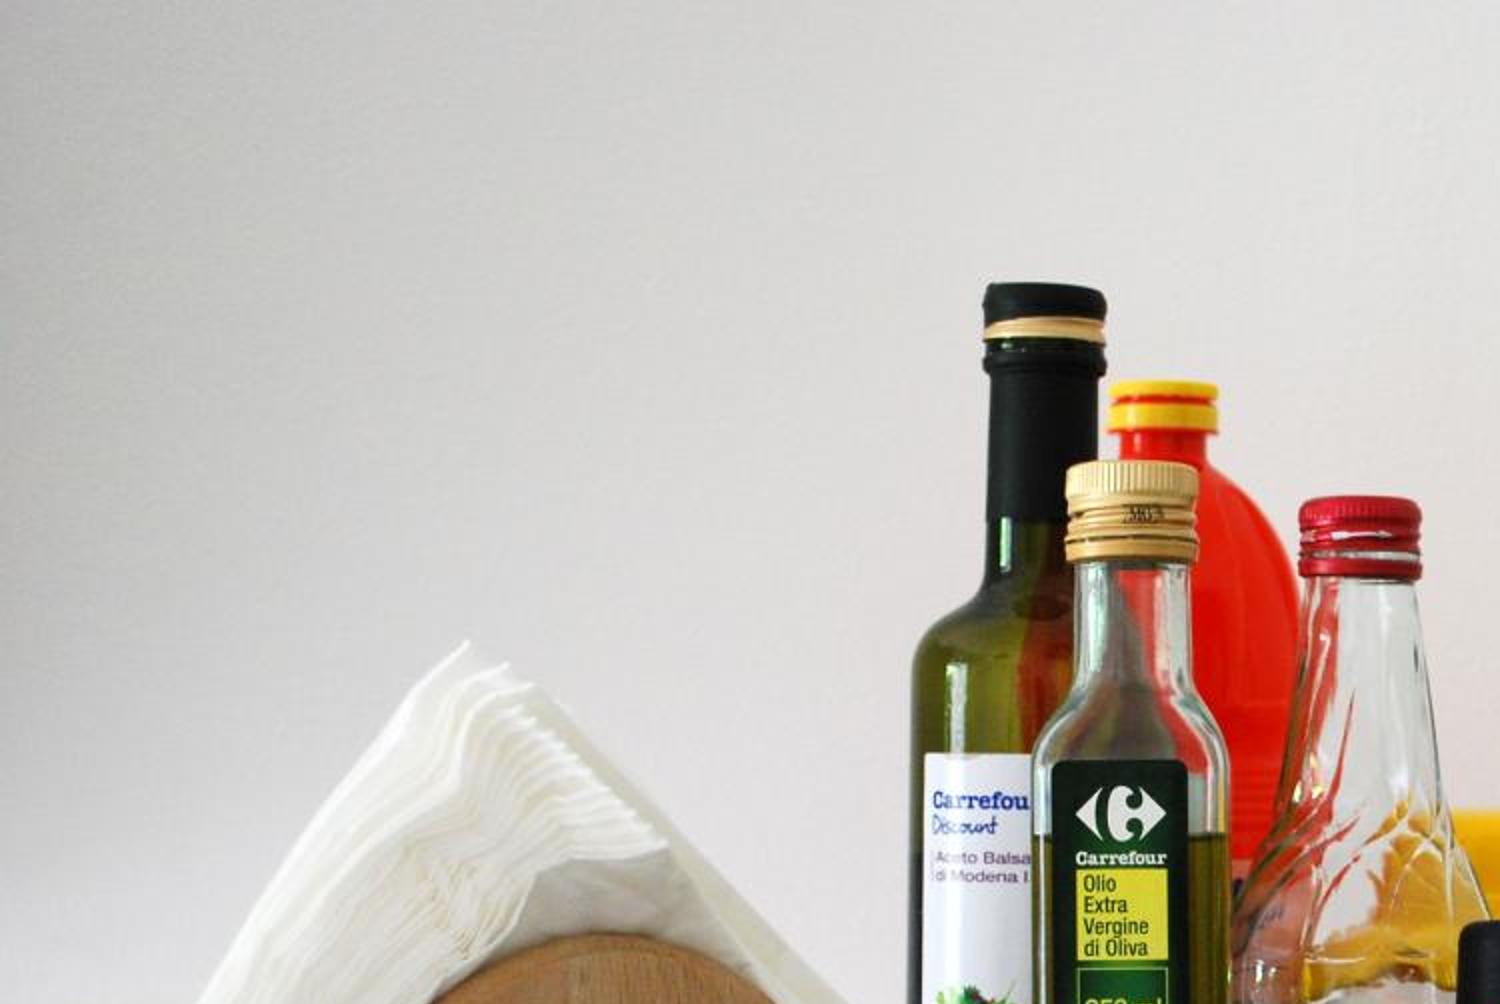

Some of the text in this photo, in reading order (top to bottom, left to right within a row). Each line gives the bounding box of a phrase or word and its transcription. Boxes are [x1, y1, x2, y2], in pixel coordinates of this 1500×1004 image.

[932, 790, 1030, 811] Carrefou
[935, 851, 1031, 865] Ato Balsa
[1076, 851, 1167, 866] Carrefour
[1084, 874, 1117, 893] Olio
[1084, 897, 1129, 914] Extra
[1084, 919, 1150, 939] Vergine
[1084, 940, 1148, 957] di Oliva
